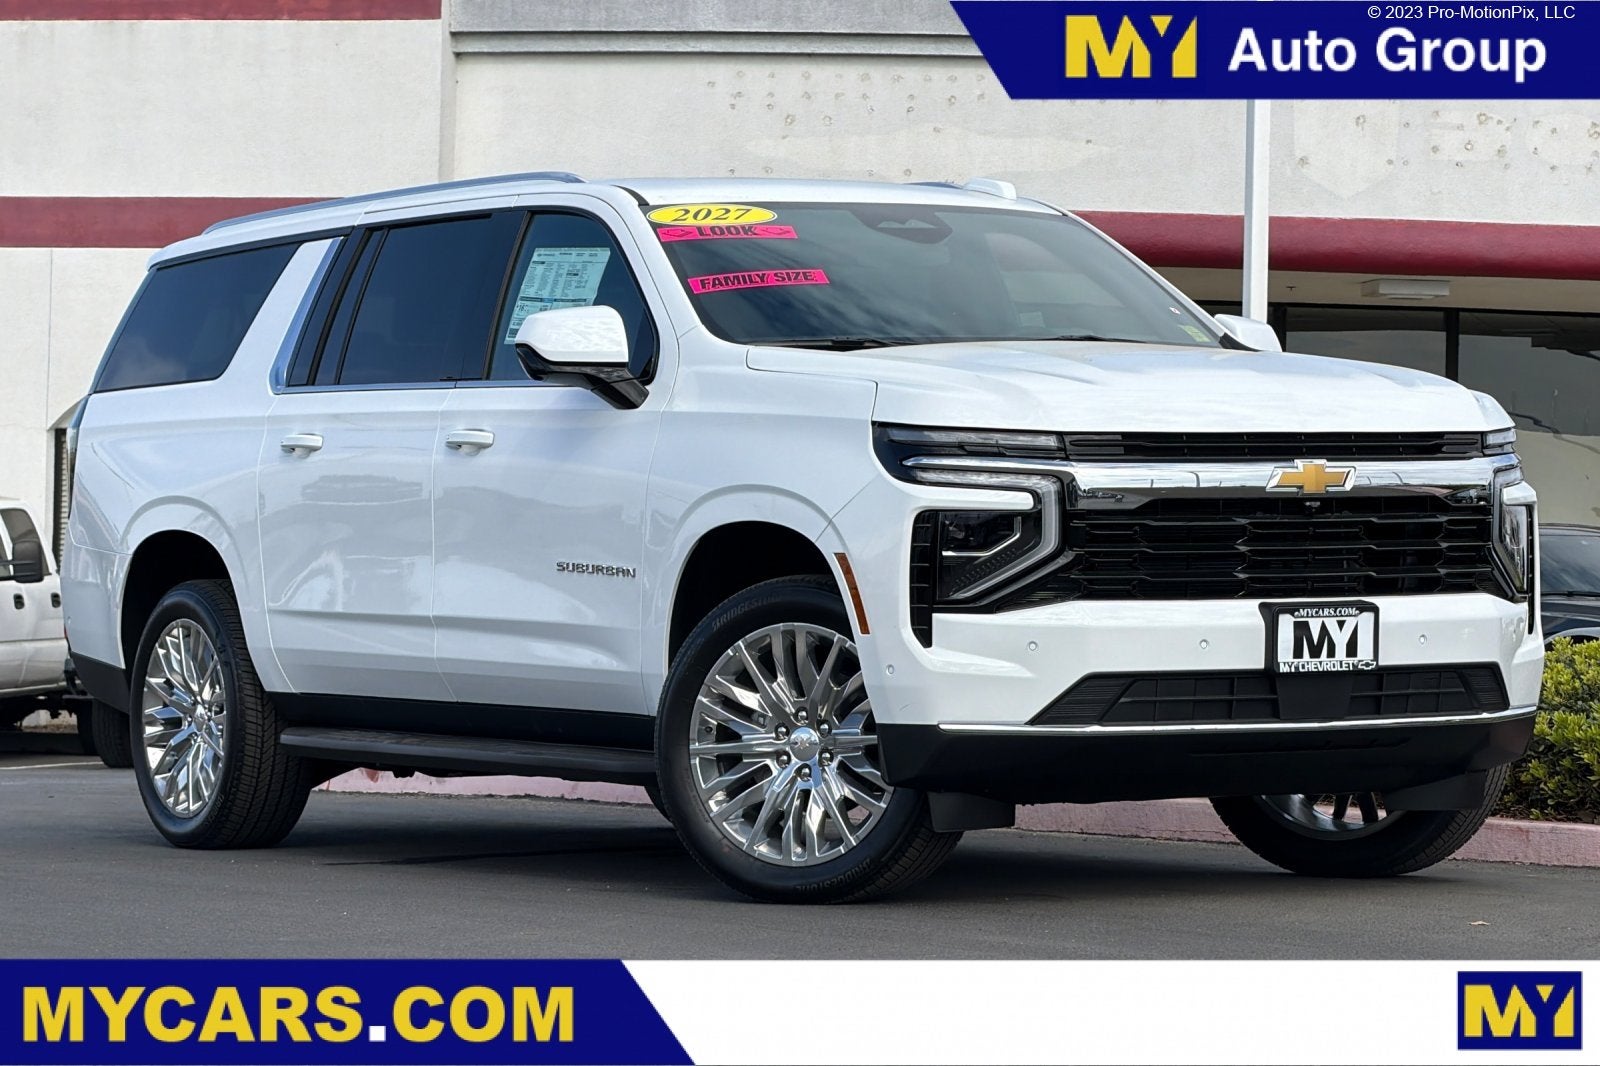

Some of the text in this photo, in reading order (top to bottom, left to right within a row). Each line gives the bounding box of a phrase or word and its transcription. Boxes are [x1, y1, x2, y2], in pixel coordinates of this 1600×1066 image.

[671, 207, 752, 222] 2027
[696, 225, 761, 237] LOOK
[700, 271, 816, 290] FAMILY SIZE
[556, 561, 636, 578] SUBURBAN
[1299, 607, 1356, 617] MYCARS.COM
[1292, 619, 1359, 659] MY
[1299, 660, 1354, 672] CHEVROLET
